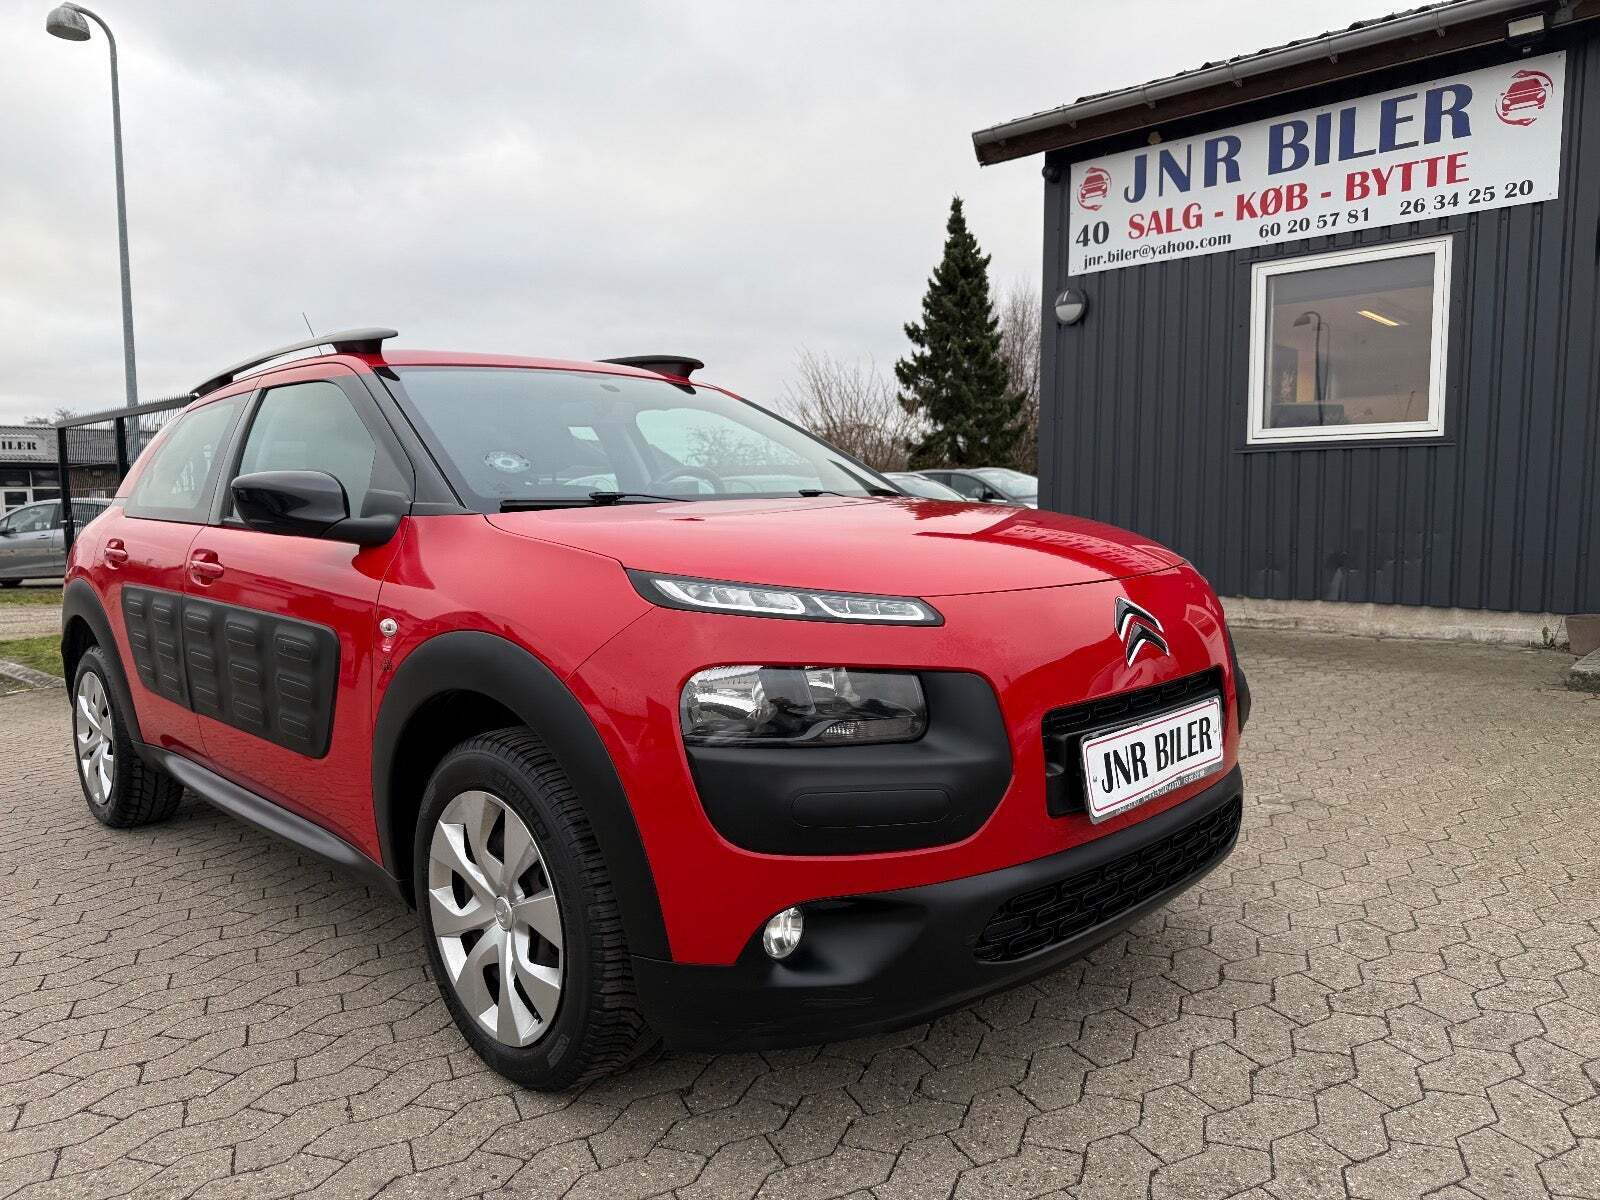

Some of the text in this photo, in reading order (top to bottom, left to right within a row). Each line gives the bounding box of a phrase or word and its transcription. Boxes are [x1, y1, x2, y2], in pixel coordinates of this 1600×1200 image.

[1123, 83, 1474, 204] JNR BILER
[1127, 151, 1470, 240] SALG - KØB - BYTTE
[1399, 179, 1534, 216] 26 34 25 20
[1075, 220, 1110, 248] 40
[1258, 207, 1370, 238] 60 20 57 81
[1083, 233, 1232, 270] jnr.biler@yahoo.com
[1102, 741, 1148, 794] JNR
[1154, 716, 1213, 773] BILER
